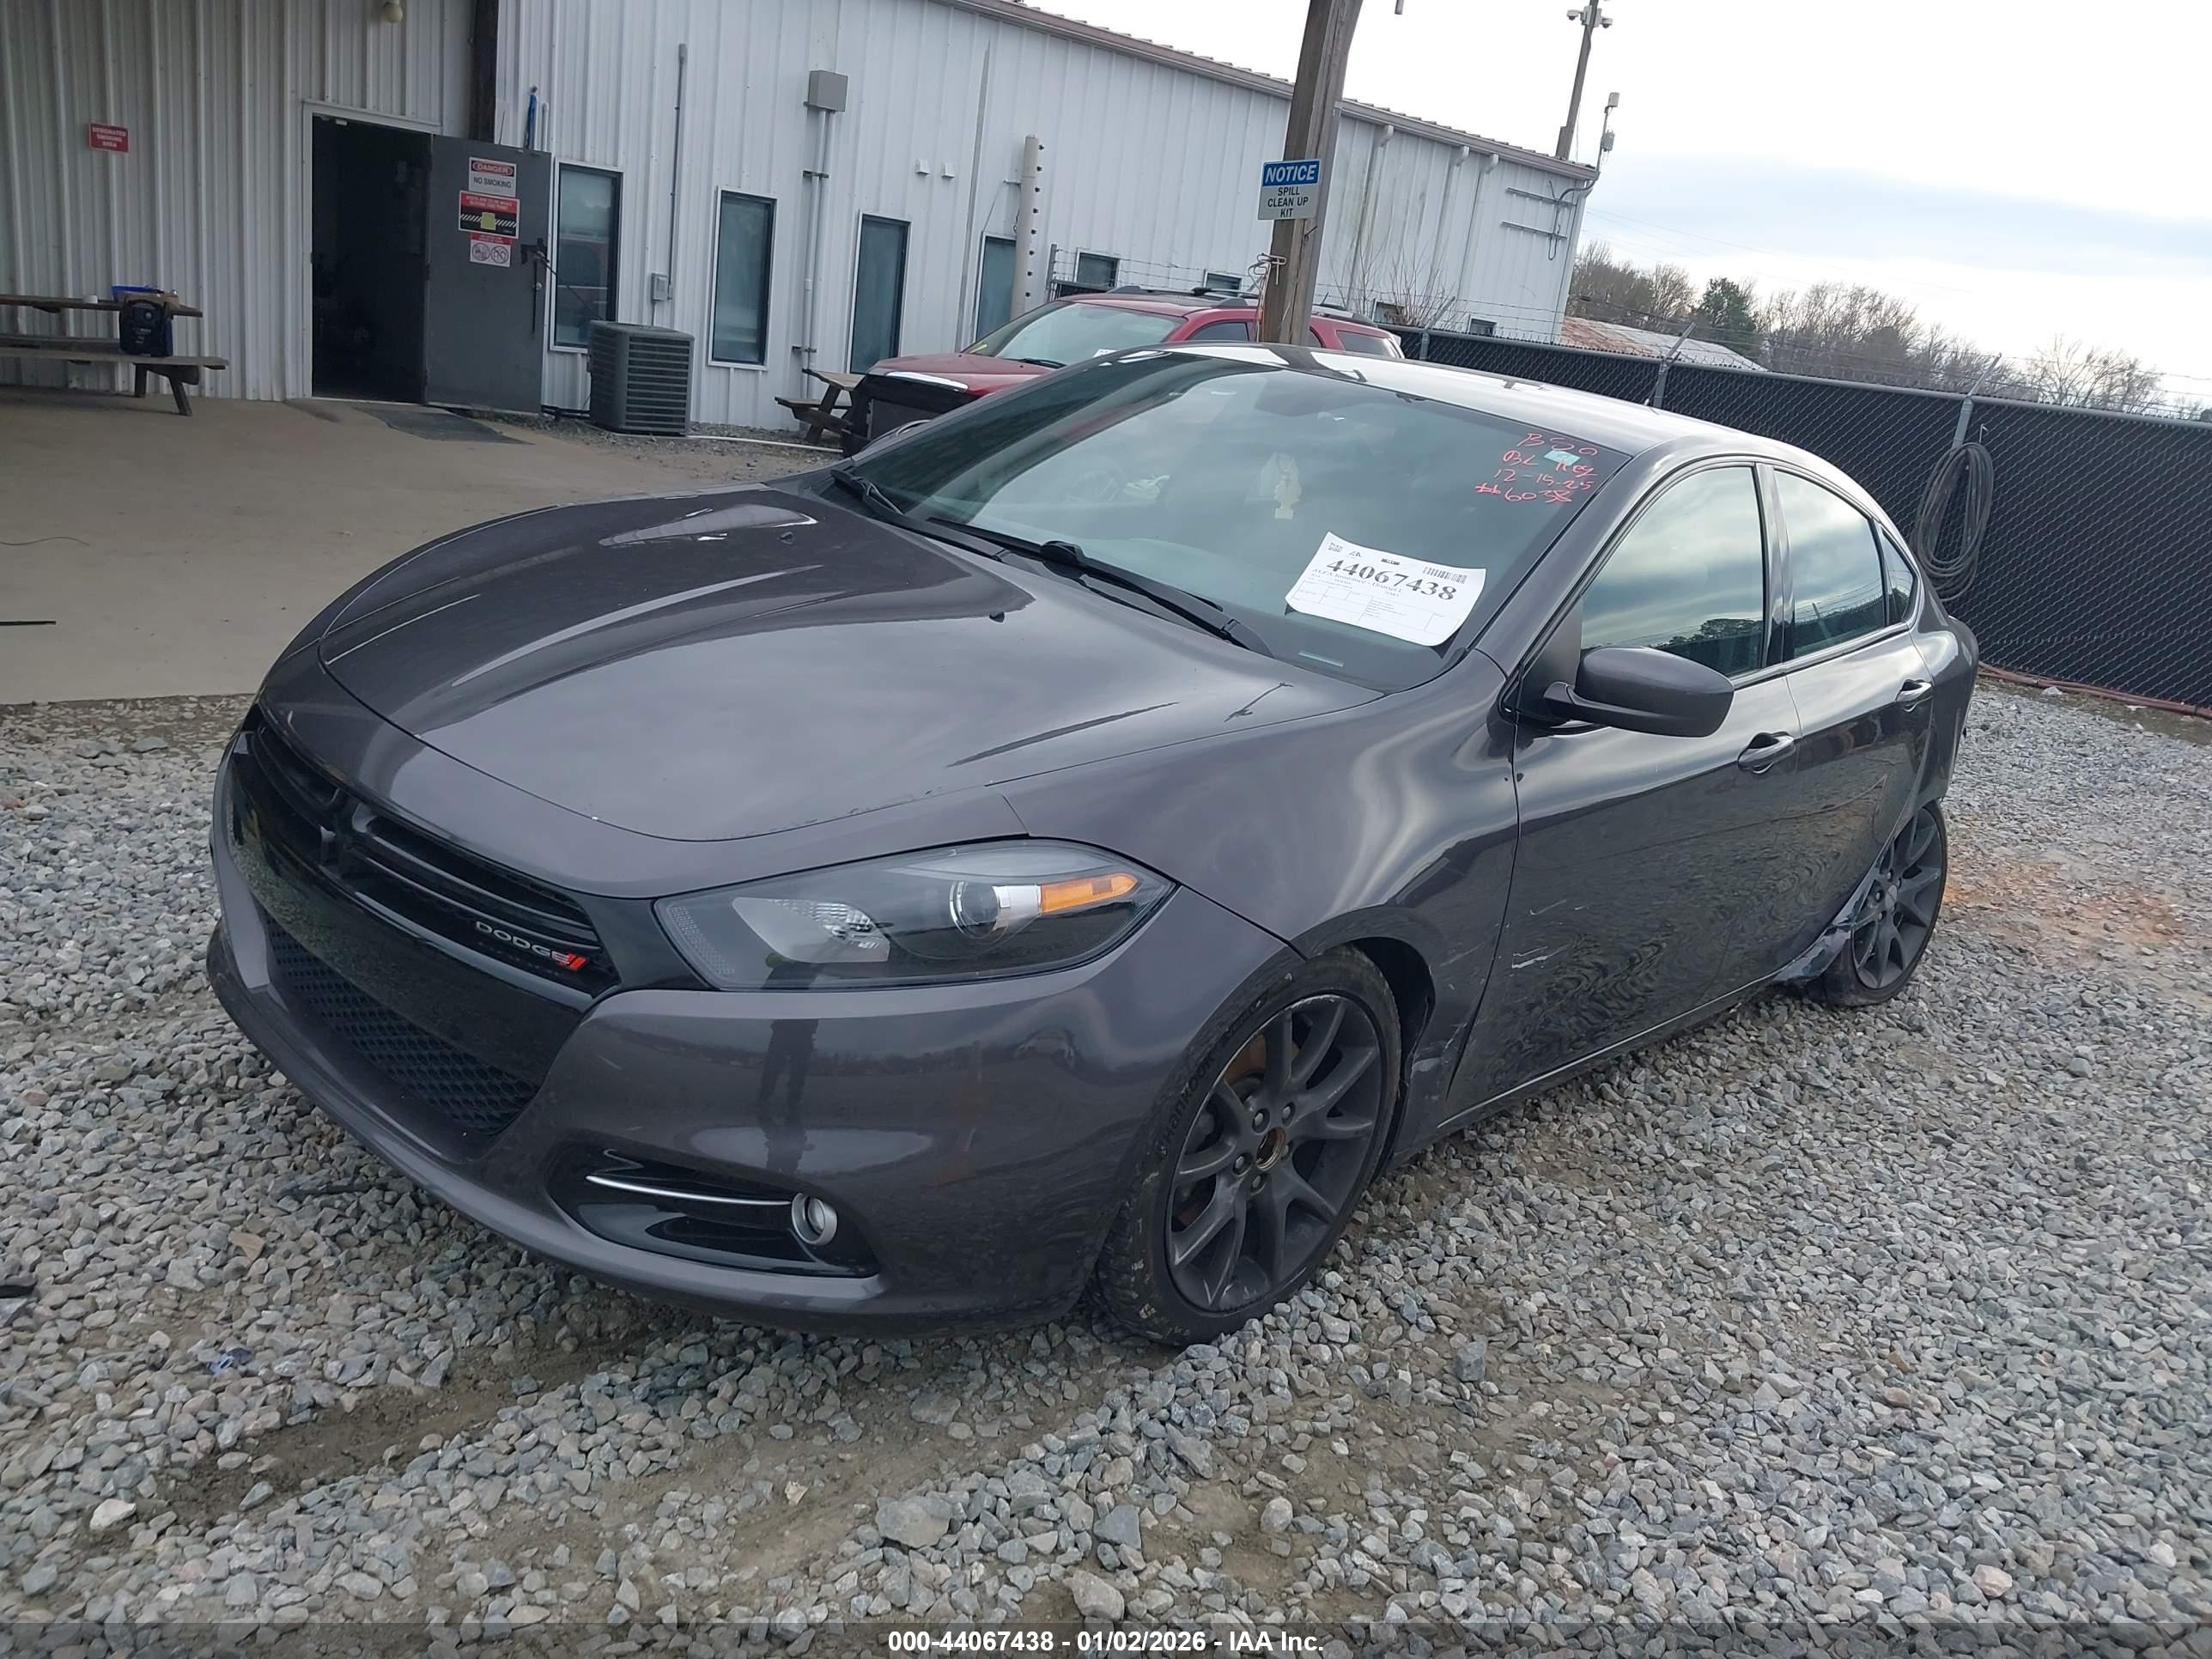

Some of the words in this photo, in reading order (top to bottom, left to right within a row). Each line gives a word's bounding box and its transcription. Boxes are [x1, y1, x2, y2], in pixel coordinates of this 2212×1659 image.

[477, 163, 508, 175] DANGER
[1264, 164, 1317, 184] NOTICE
[483, 178, 512, 188] SMOKING
[1278, 186, 1301, 197] SPILL
[1267, 198, 1294, 208] CLEAN
[1297, 197, 1309, 206] UP
[1280, 208, 1294, 218] KIT
[1326, 559, 1457, 600] 44067438
[476, 921, 571, 965] DODGE
